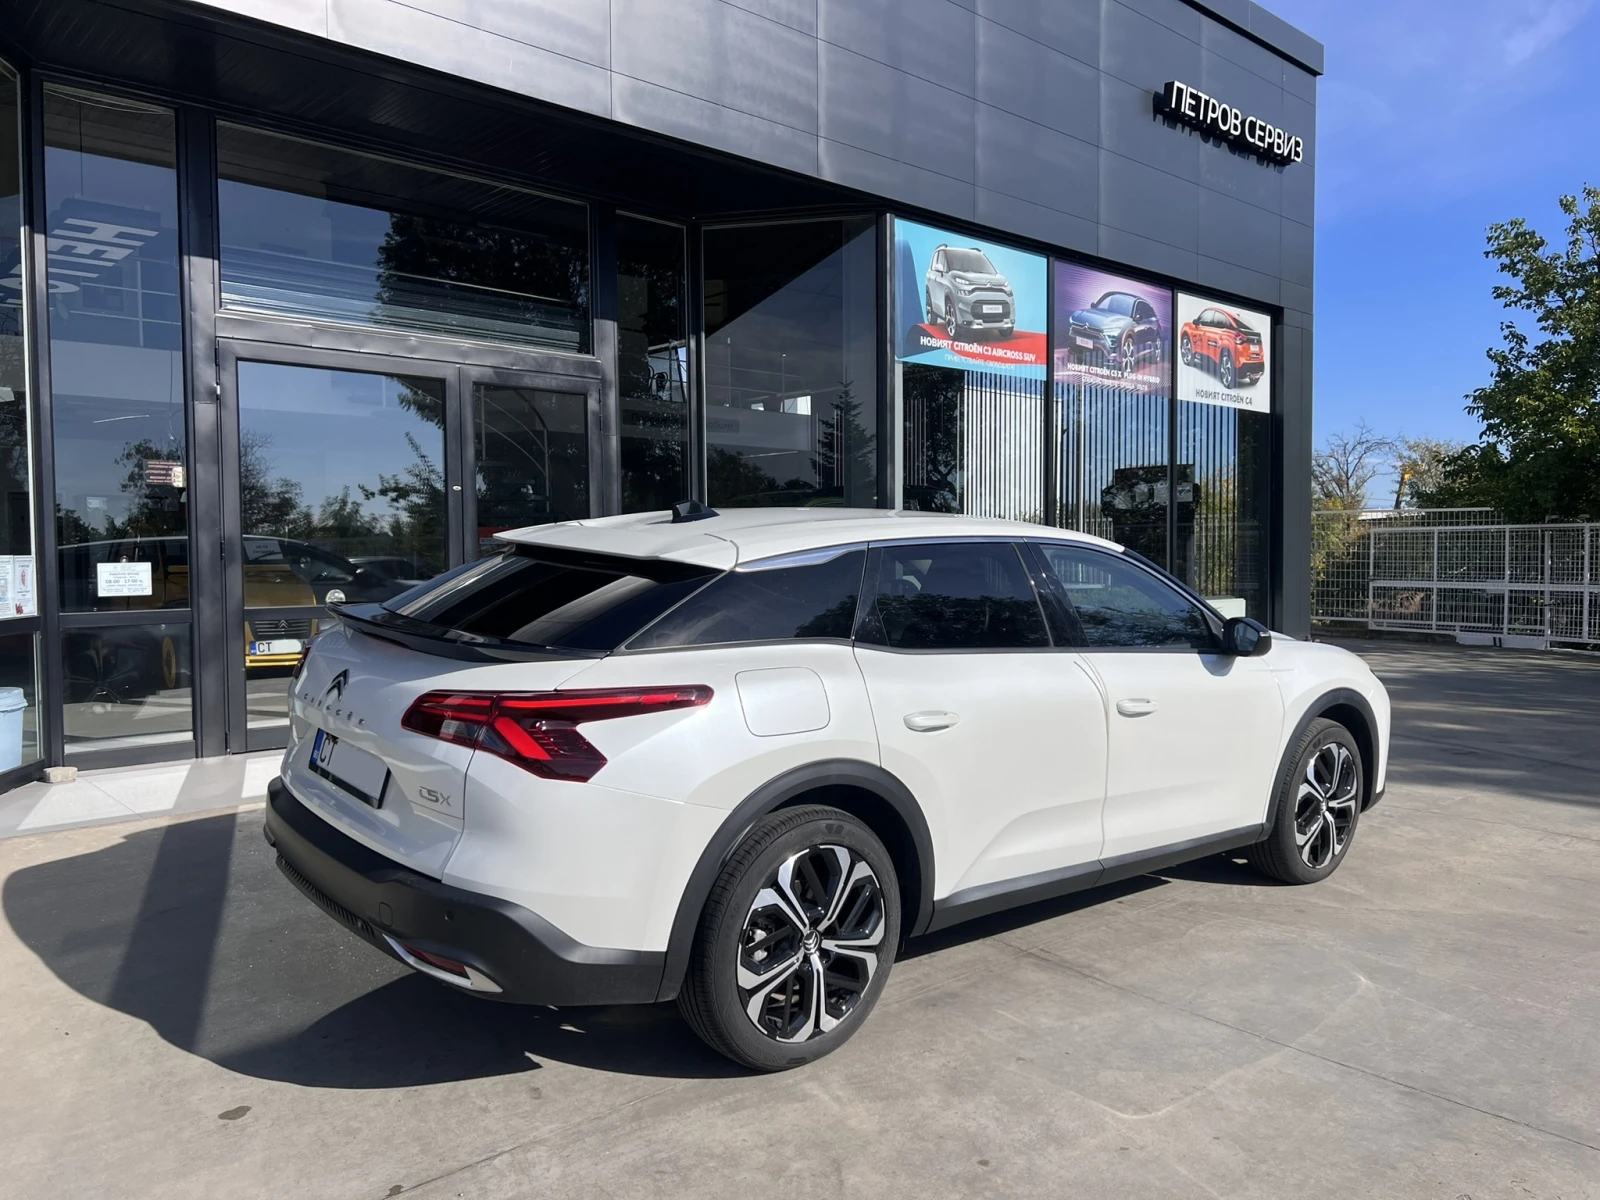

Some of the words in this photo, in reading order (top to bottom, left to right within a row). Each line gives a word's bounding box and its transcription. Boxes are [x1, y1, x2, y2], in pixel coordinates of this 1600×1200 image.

[1171, 80, 1241, 136] ПЕТРОВ
[1245, 116, 1303, 163] СЕРВИЗ
[920, 336, 953, 350] НОВИЯТ
[954, 341, 983, 354] CITROËN
[983, 346, 992, 356] C3
[992, 347, 1023, 361] AIRCROSS
[1023, 352, 1036, 362] SUV
[1067, 362, 1089, 373] НОВИЯТ
[1089, 366, 1111, 377] CITROËN
[1195, 389, 1220, 401] НОВИЯТ
[1220, 392, 1244, 404] CITROËN
[1245, 396, 1253, 405] C4
[258, 642, 272, 653] CT
[319, 735, 339, 767] CT
